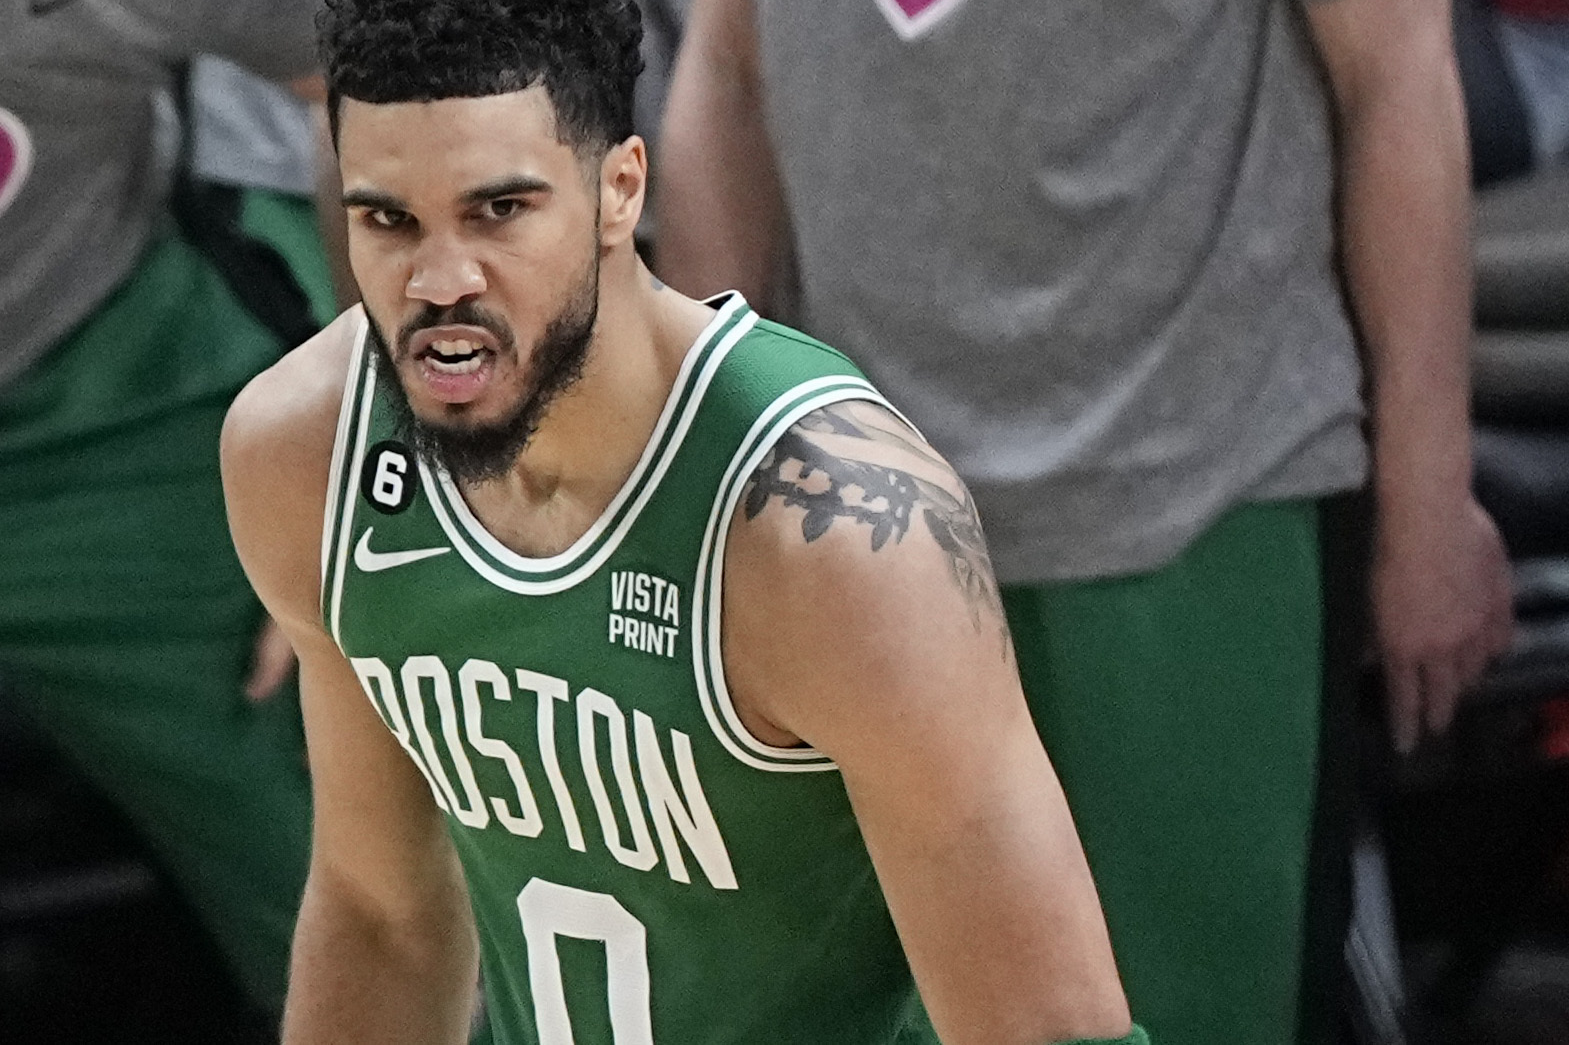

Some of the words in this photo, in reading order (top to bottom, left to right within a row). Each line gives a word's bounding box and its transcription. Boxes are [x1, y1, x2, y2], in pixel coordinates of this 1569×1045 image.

[371, 450, 408, 508] 6
[611, 571, 680, 627] VISTA
[609, 614, 679, 658] PRINT
[517, 876, 654, 1045] 0
